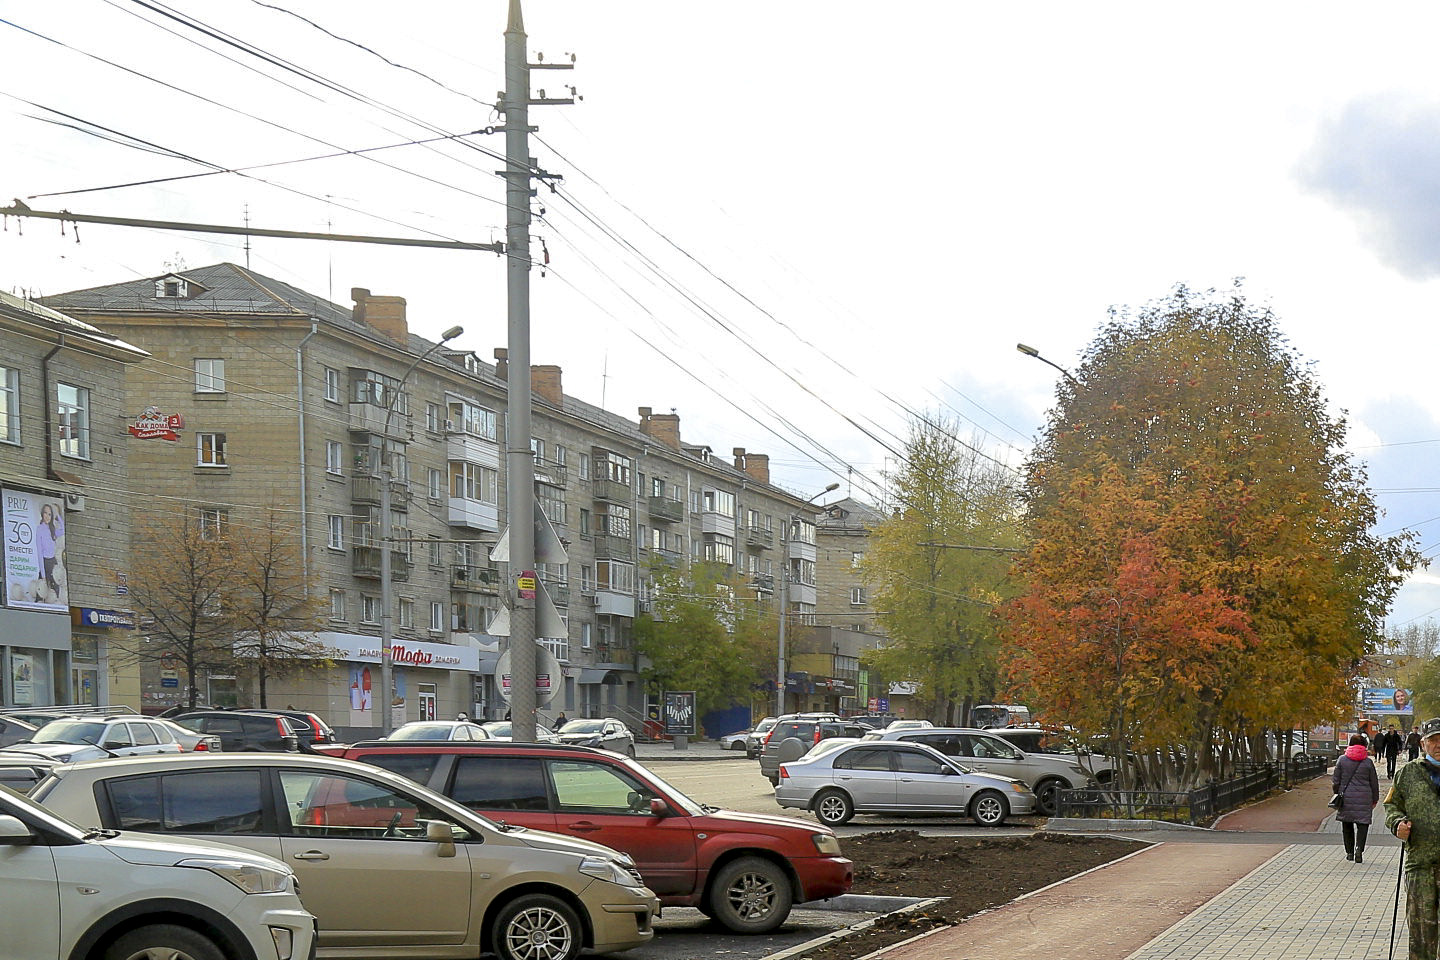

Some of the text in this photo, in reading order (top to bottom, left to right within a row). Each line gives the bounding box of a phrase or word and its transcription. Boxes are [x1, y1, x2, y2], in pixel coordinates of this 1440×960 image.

[8, 496, 28, 511] PRIZ
[8, 519, 33, 545] 30
[391, 645, 433, 666] Тофа
